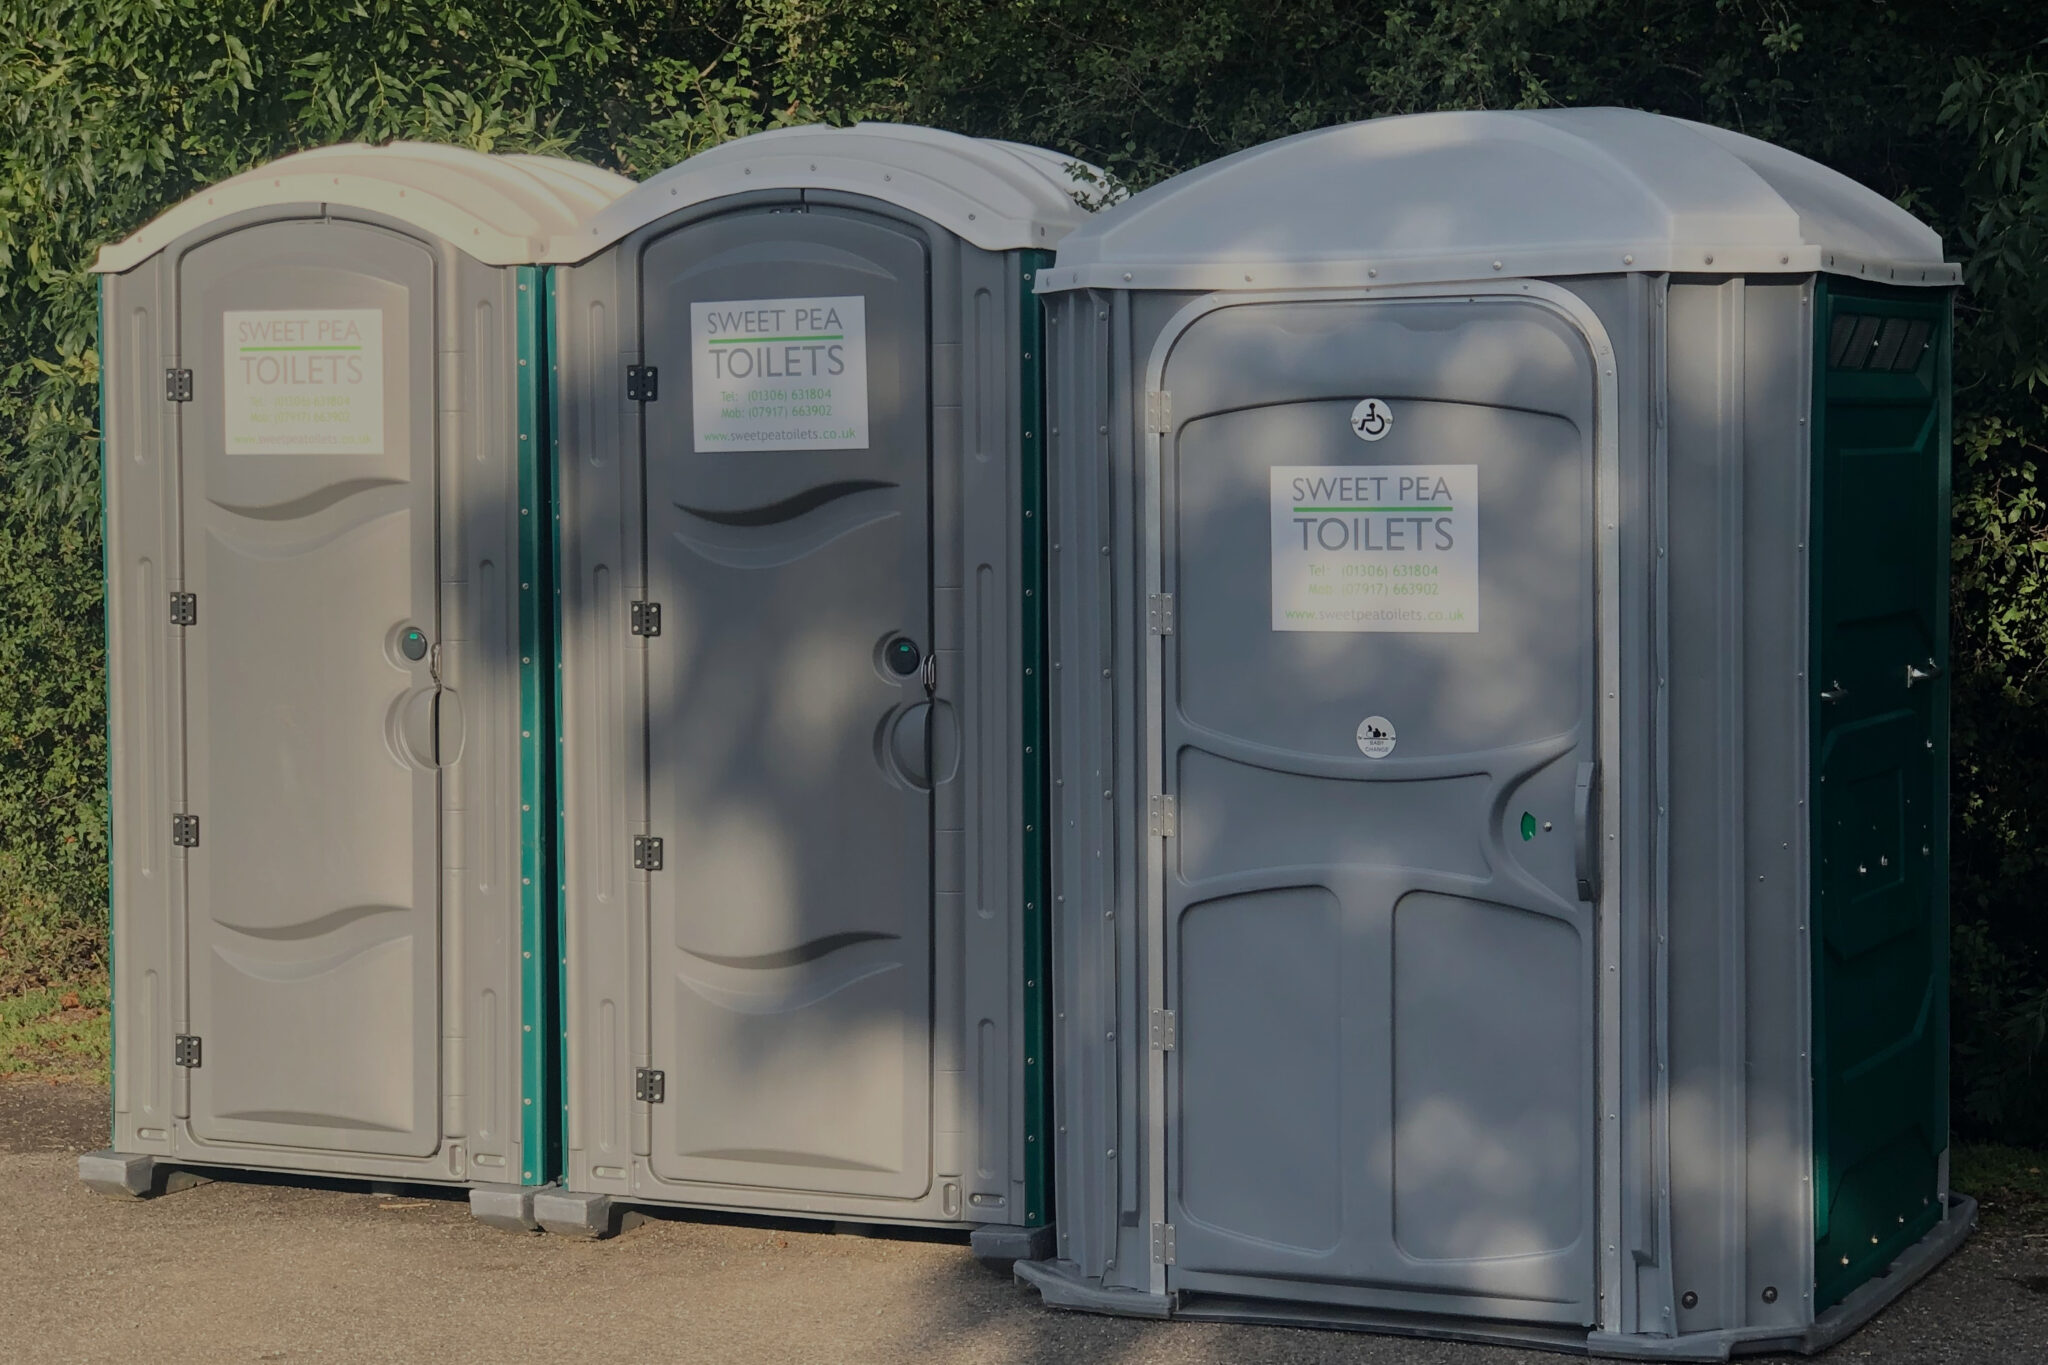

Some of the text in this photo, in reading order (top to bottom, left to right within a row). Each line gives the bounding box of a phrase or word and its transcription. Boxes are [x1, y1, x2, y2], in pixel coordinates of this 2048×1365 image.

[707, 307, 843, 334] SWEET PEA
[239, 319, 362, 343] SWEET PEA
[239, 355, 363, 385] TOILETS
[708, 344, 845, 379] TOILETS
[720, 388, 832, 402] Tel: (01306) 631804
[720, 405, 832, 419] Mob: (07917) 663902
[704, 428, 856, 443] www.sweetpeatoilets.co.uk
[1292, 476, 1453, 502] SWEET PEA
[1293, 517, 1454, 551] TOILETS
[1308, 563, 1438, 578] Tel: (01306) 631804
[1342, 583, 1388, 597] (07917)
[1392, 583, 1439, 596] 663902
[1285, 608, 1464, 623] www.sweetpeatoilets.co.uk
